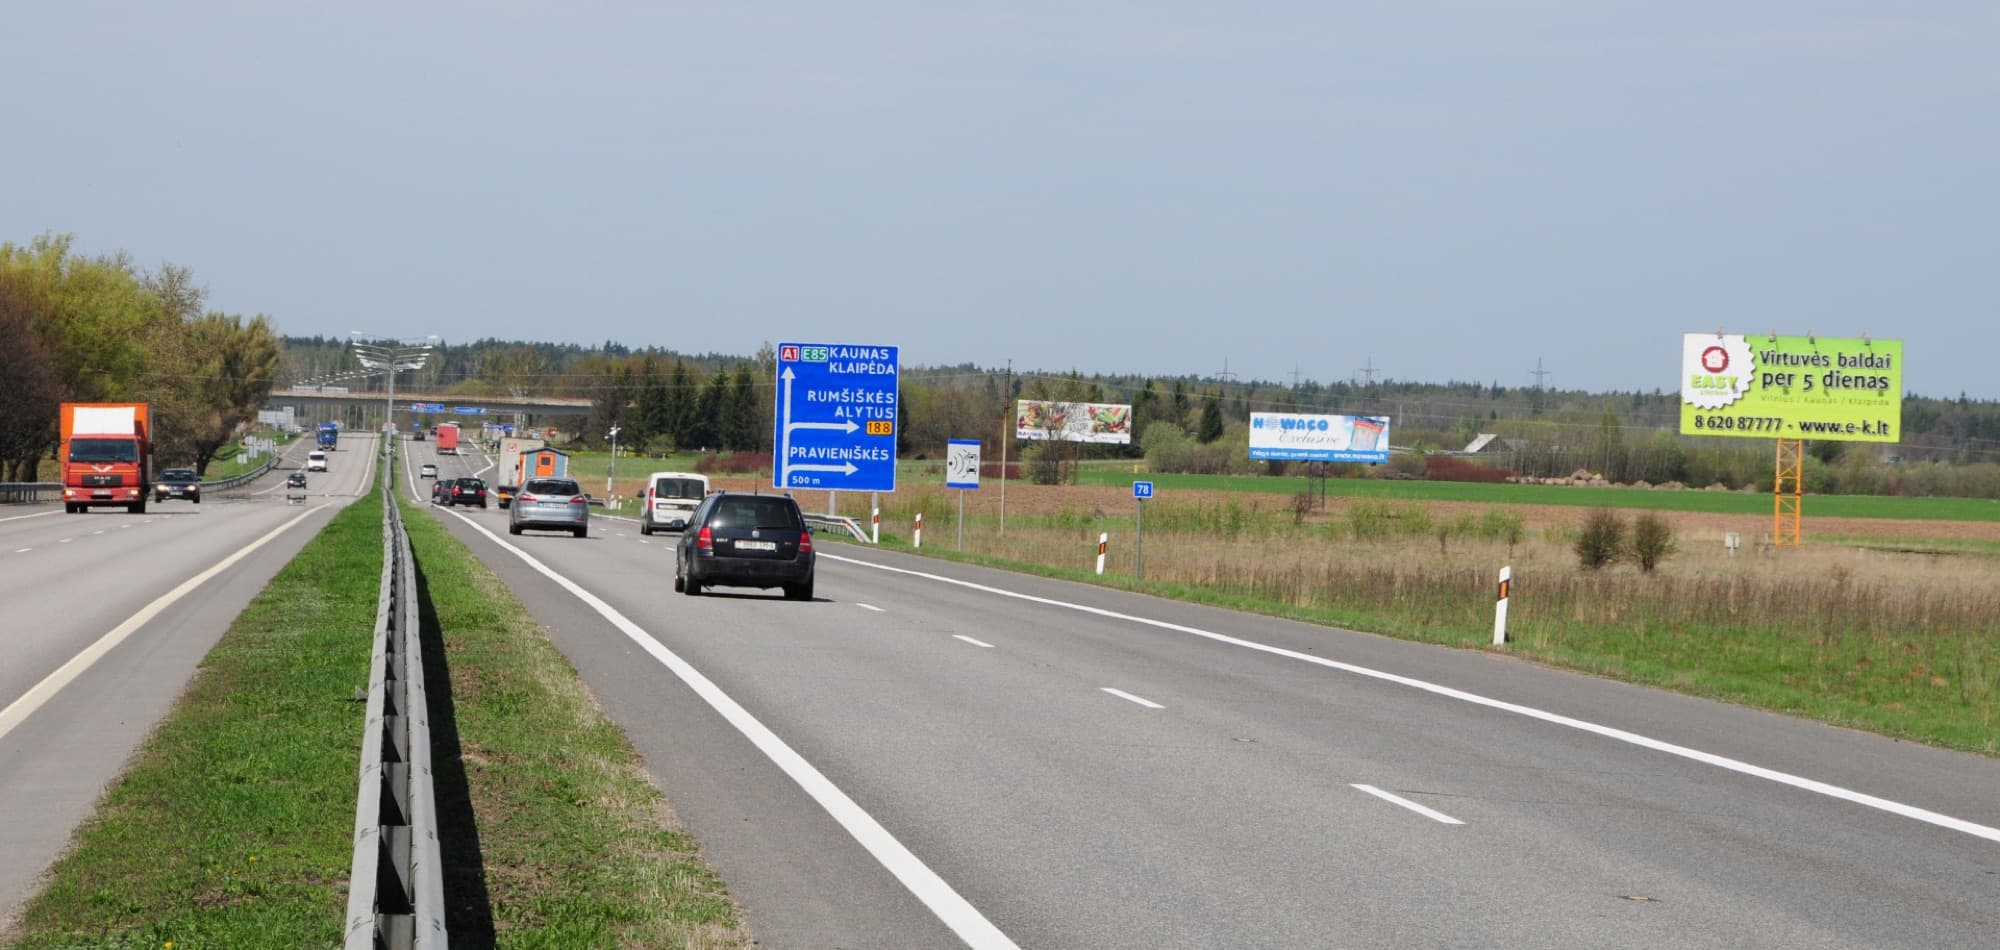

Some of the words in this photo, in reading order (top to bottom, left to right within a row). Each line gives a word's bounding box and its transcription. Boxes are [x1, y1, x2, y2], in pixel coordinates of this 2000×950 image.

[783, 348, 798, 360] A1
[803, 349, 827, 361] E85
[829, 347, 890, 361] KAUNAS
[1760, 350, 1831, 368] Virtuvės
[1837, 351, 1891, 369] baldai
[829, 360, 896, 375] KLAIPĖDA
[1690, 374, 1738, 390] EASY
[1762, 371, 1796, 389] per
[1802, 375, 1813, 391] 5
[1822, 370, 1890, 390] dienas
[807, 388, 895, 404] RUMŠIŠKĖS
[834, 406, 895, 419] ALYTUS
[868, 422, 891, 433] 188
[1695, 415, 1703, 429] 8
[1707, 415, 1734, 430] 620
[1737, 416, 1783, 431] 87777
[1799, 420, 1890, 436] www.e-k.lt
[790, 446, 890, 461] PRAVIENIŠKĖS
[792, 475, 810, 485] 500
[812, 477, 821, 485] m
[1137, 484, 1149, 495] 78
